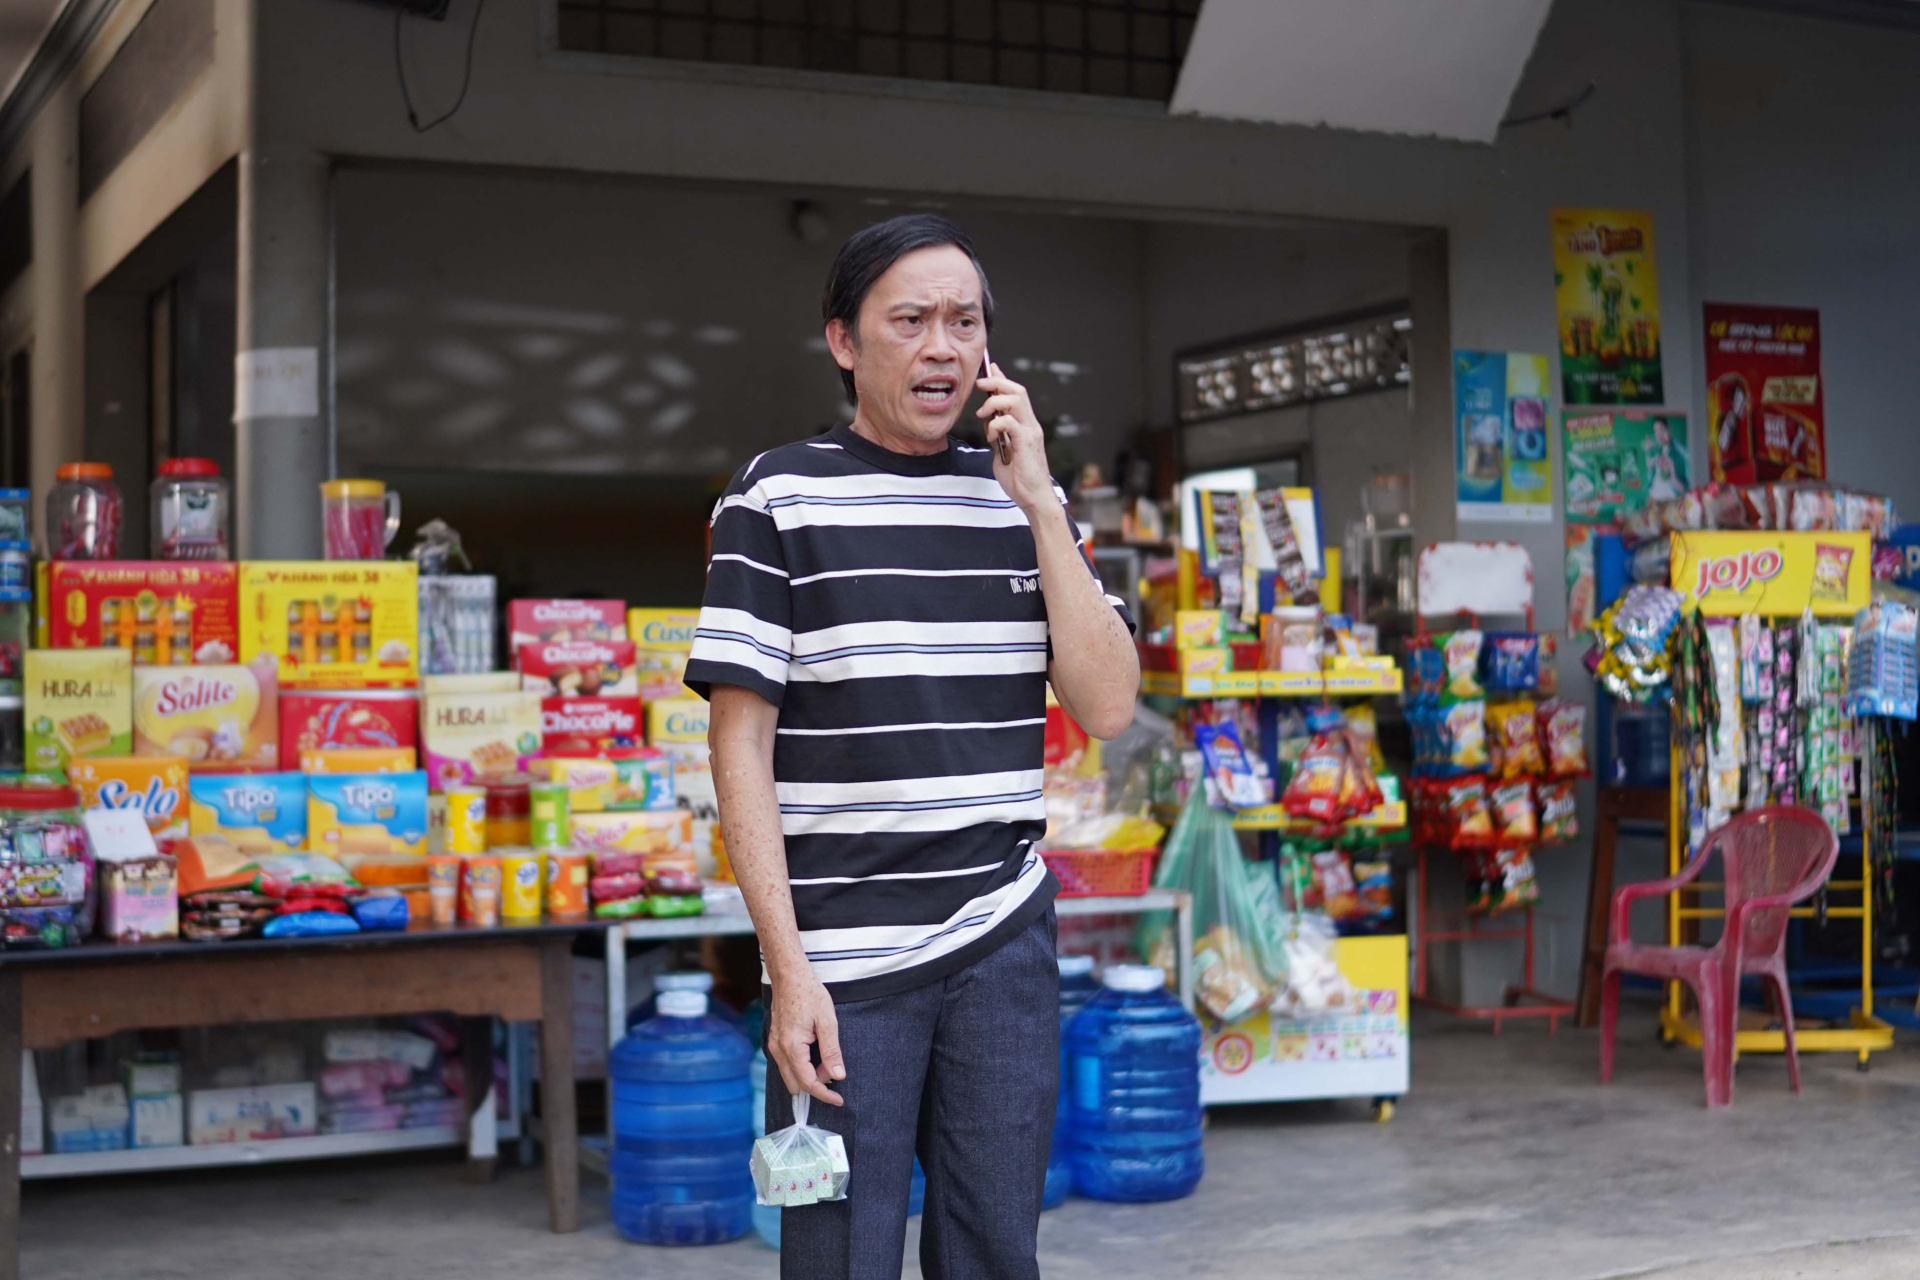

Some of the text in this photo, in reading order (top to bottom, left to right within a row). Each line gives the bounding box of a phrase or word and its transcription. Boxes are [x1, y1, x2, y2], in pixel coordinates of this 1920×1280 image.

[1693, 549, 1782, 600] JOJO
[156, 680, 236, 717] Solite
[224, 786, 275, 809] Tipo
[343, 785, 394, 808] Tipo
